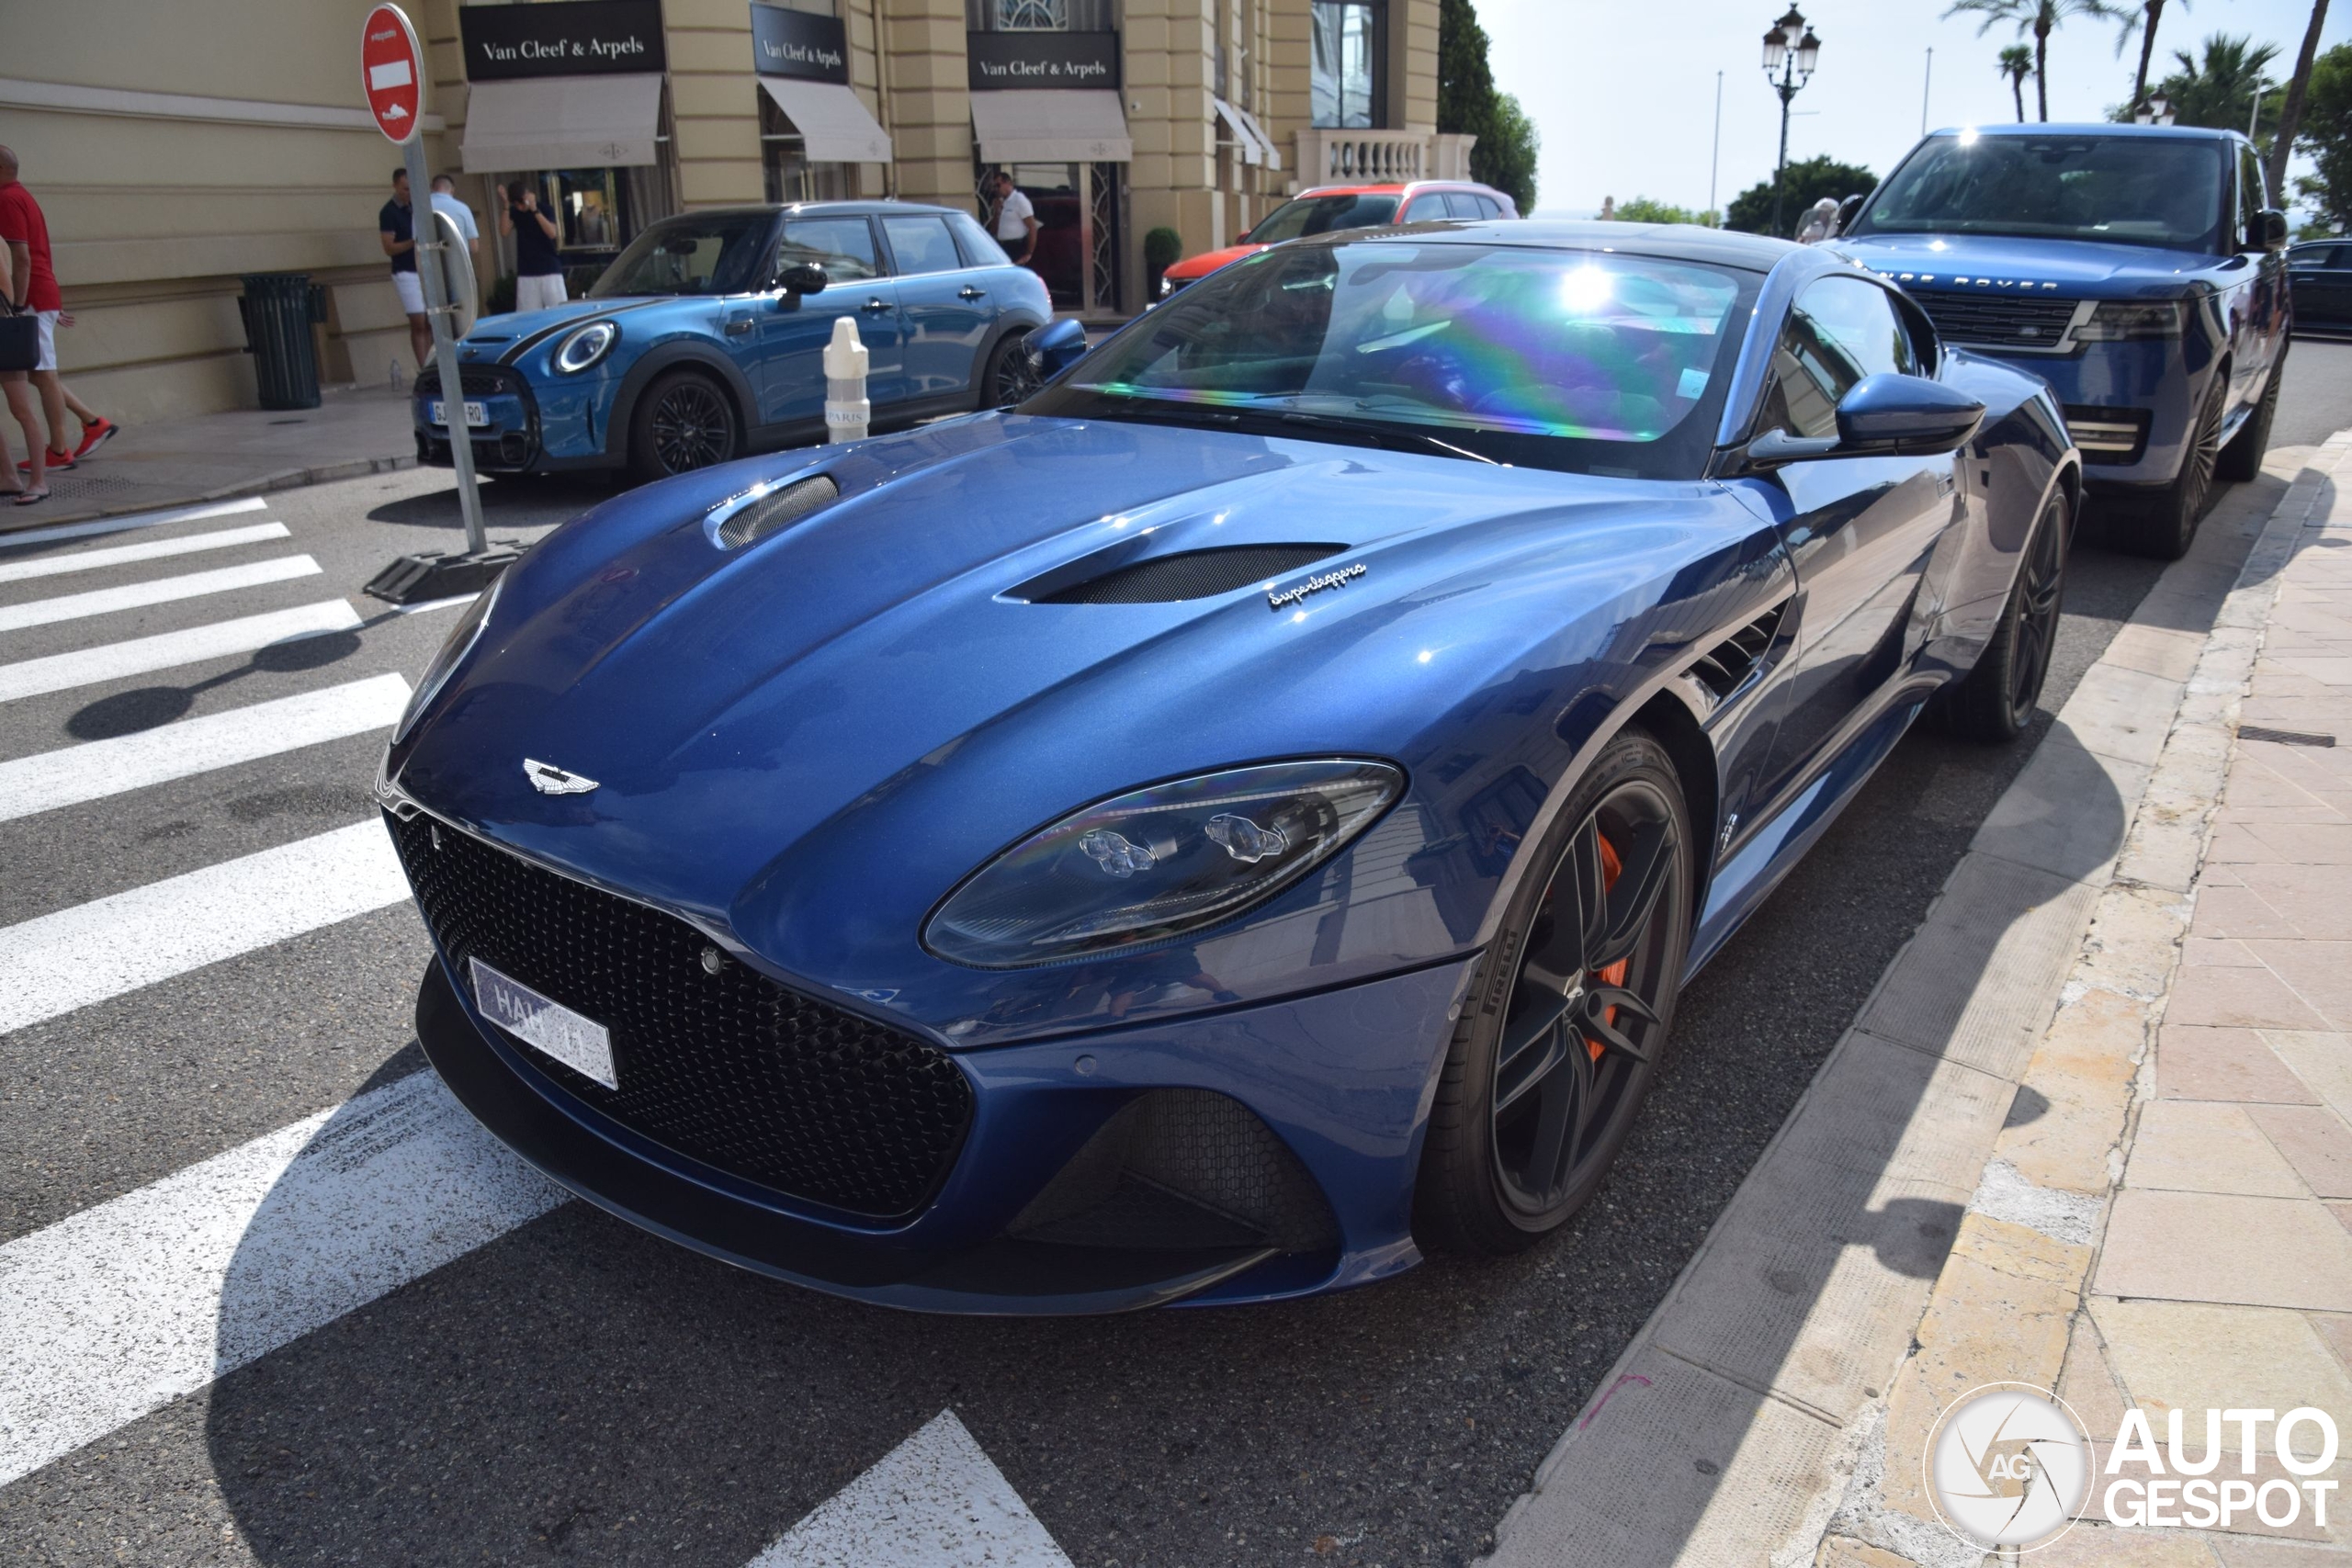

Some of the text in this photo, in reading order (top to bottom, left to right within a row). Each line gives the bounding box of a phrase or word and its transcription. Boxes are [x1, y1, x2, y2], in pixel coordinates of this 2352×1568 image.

[483, 35, 644, 61] Van Cleef & Arpels
[763, 39, 842, 70] Van Cleef & Arpels
[979, 60, 1106, 80] Van Cleef & Arpels
[1954, 276, 2058, 290] ROVER
[828, 412, 863, 424] PARIS
[1268, 562, 1367, 606] Superleggera
[1482, 927, 1519, 1016] PIRELLI
